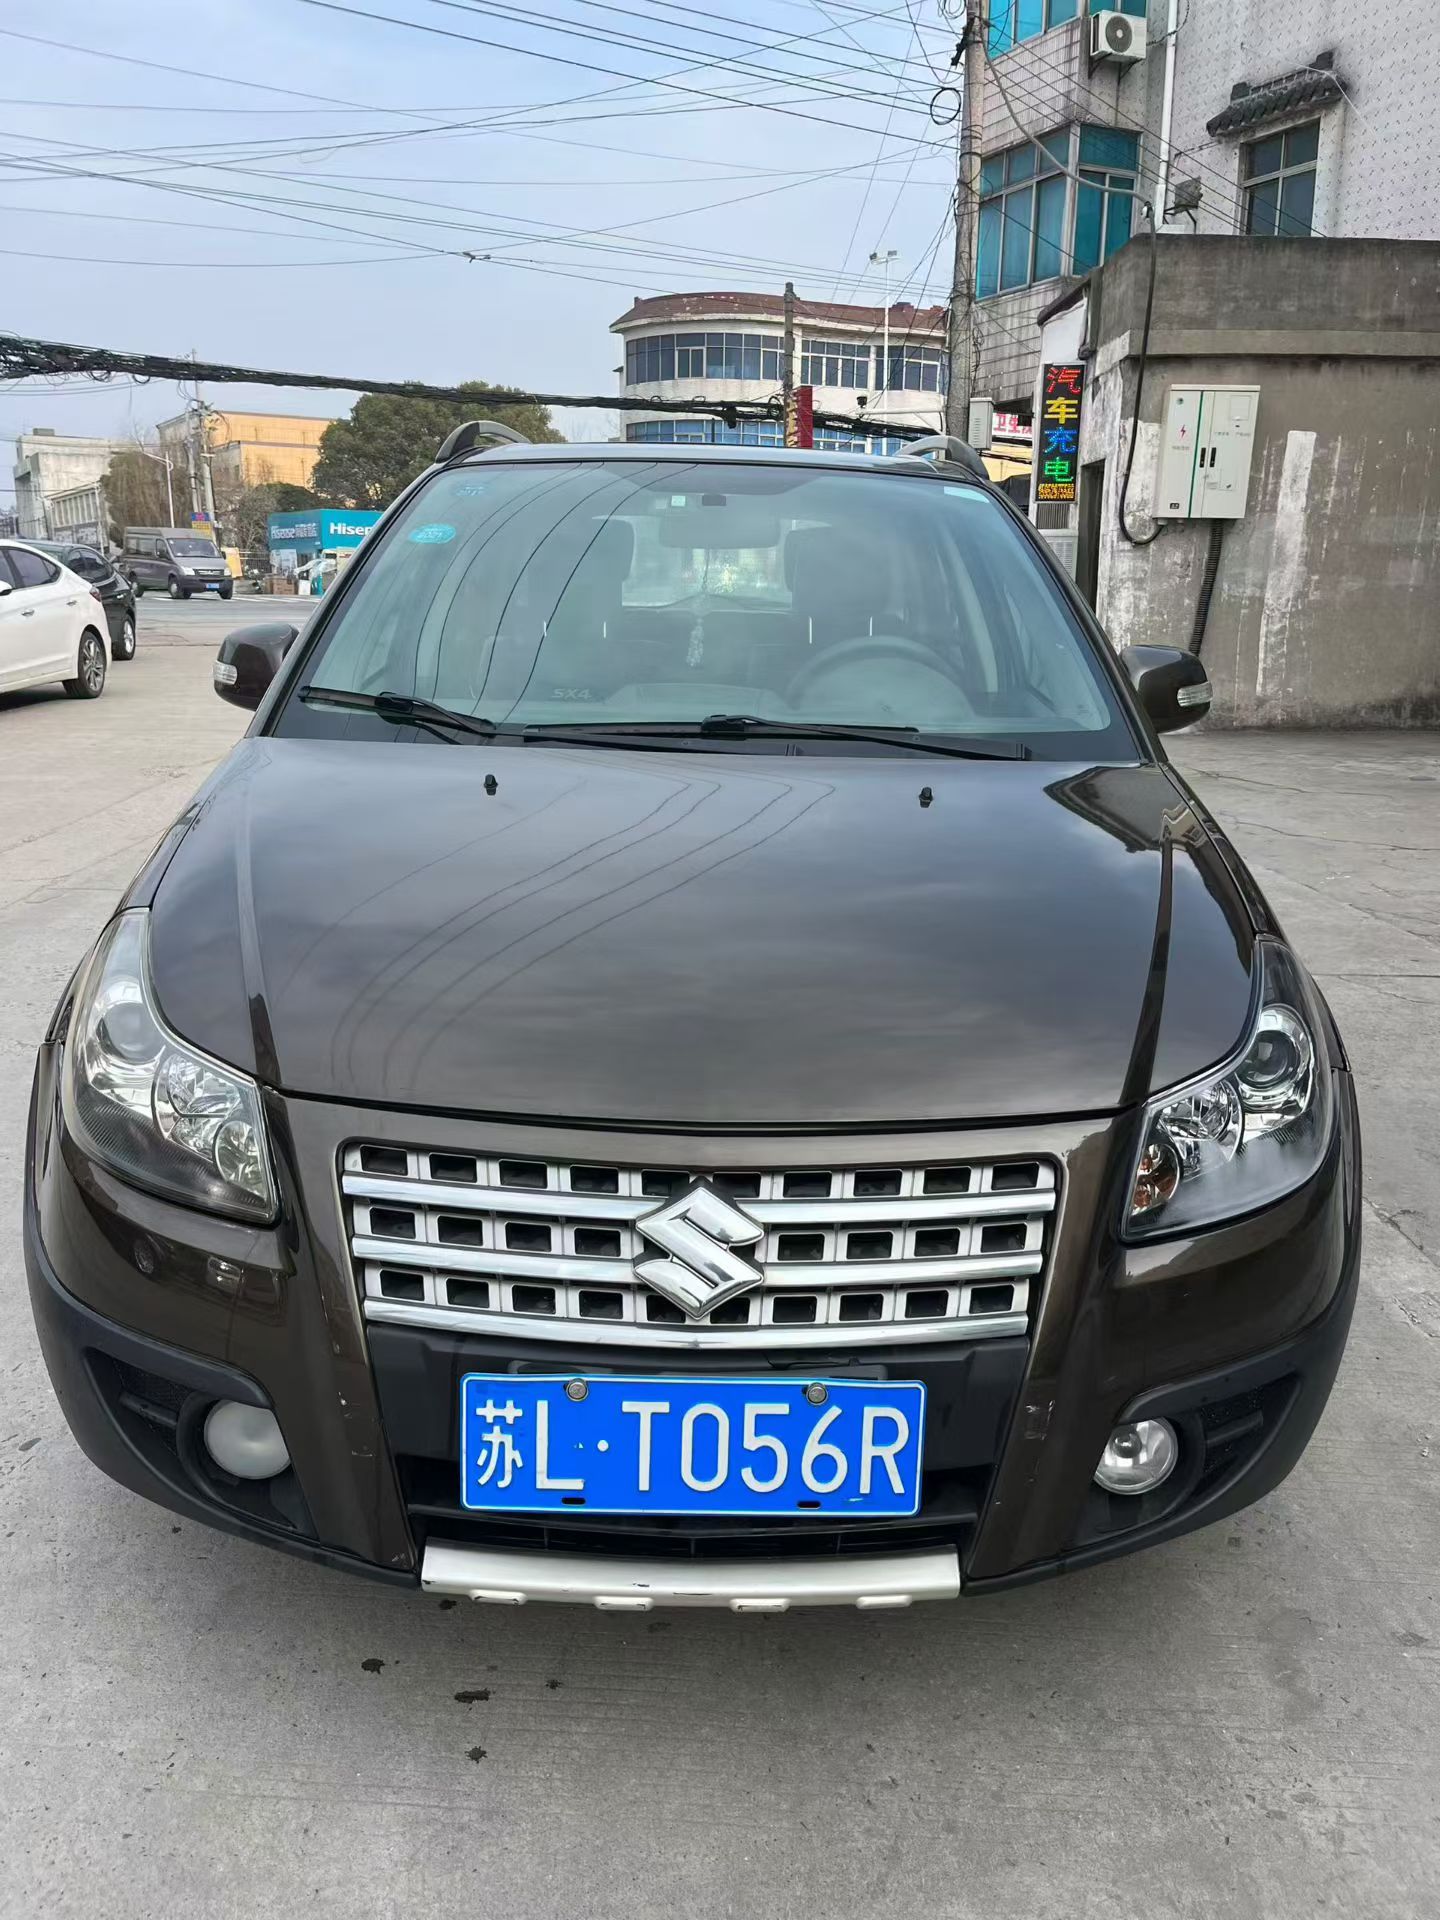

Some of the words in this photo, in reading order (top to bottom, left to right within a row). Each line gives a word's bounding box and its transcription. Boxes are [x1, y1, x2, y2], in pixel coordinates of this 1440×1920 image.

[1043, 366, 1080, 482] 汽车充电
[551, 688, 592, 700] SX4
